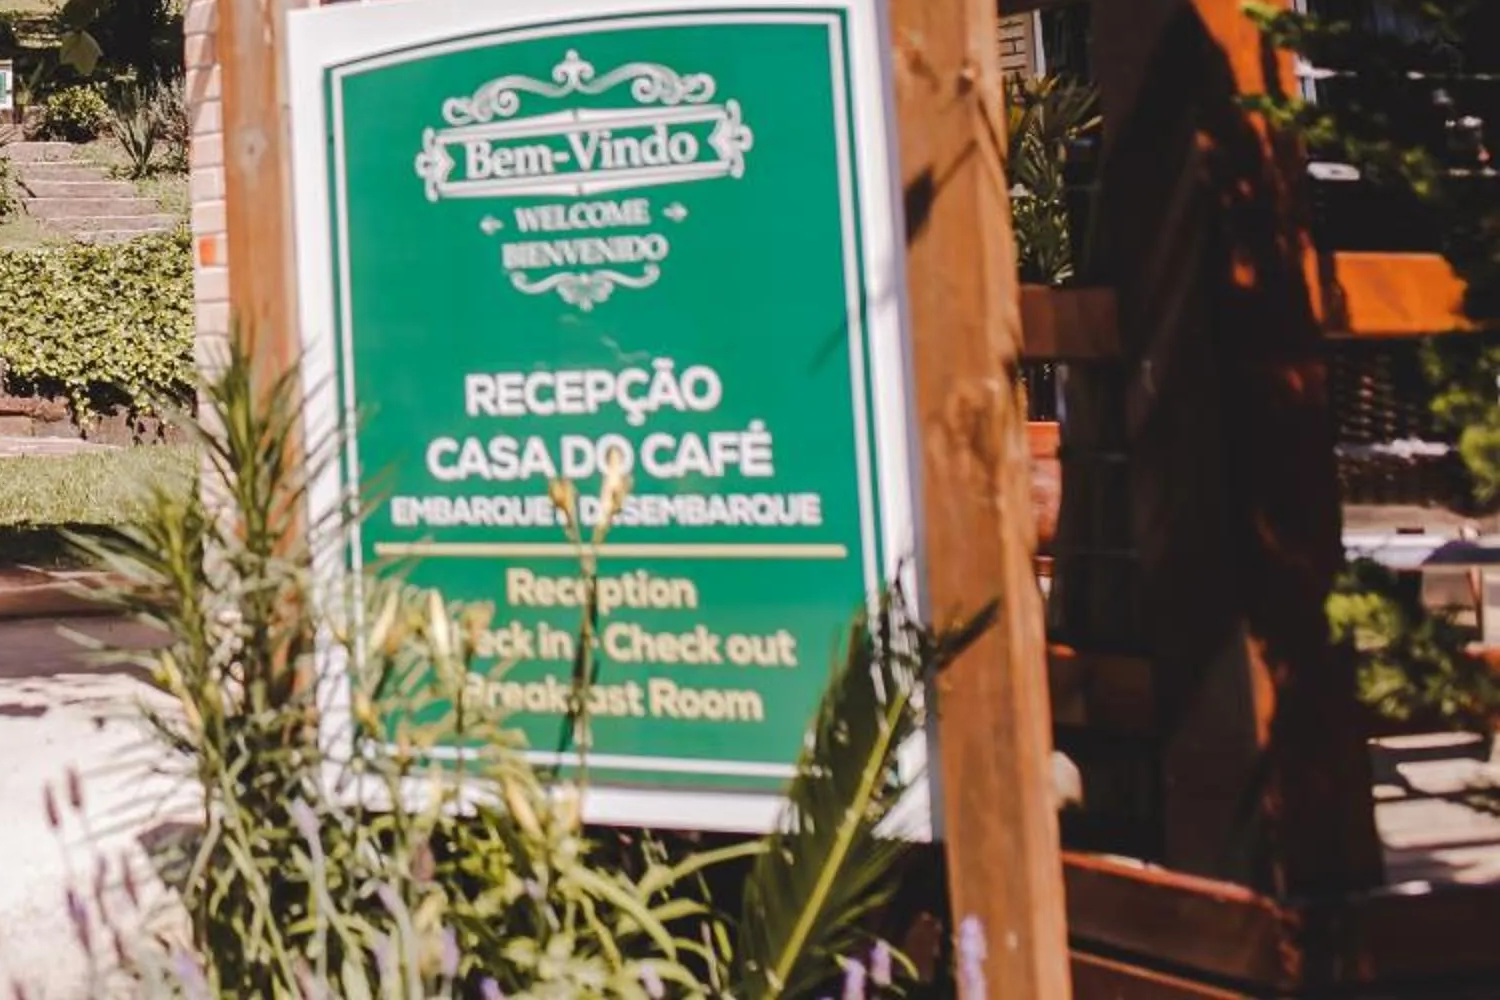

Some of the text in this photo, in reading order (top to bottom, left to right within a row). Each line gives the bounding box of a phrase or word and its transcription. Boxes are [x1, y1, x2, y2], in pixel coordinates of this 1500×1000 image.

[465, 122, 697, 179] Bem-Vindo
[514, 198, 651, 232] WELCOME
[502, 234, 668, 269] BIENVENIDO
[465, 358, 722, 426] RECEPÇÃO
[426, 420, 774, 481] CASA DO CAFÉ
[390, 496, 554, 527] EMBARQUE
[579, 493, 823, 527] DSEMBARQUE
[537, 621, 574, 661] in
[603, 621, 722, 664] Check
[725, 628, 798, 667] out
[462, 671, 764, 722] Breakast Room
